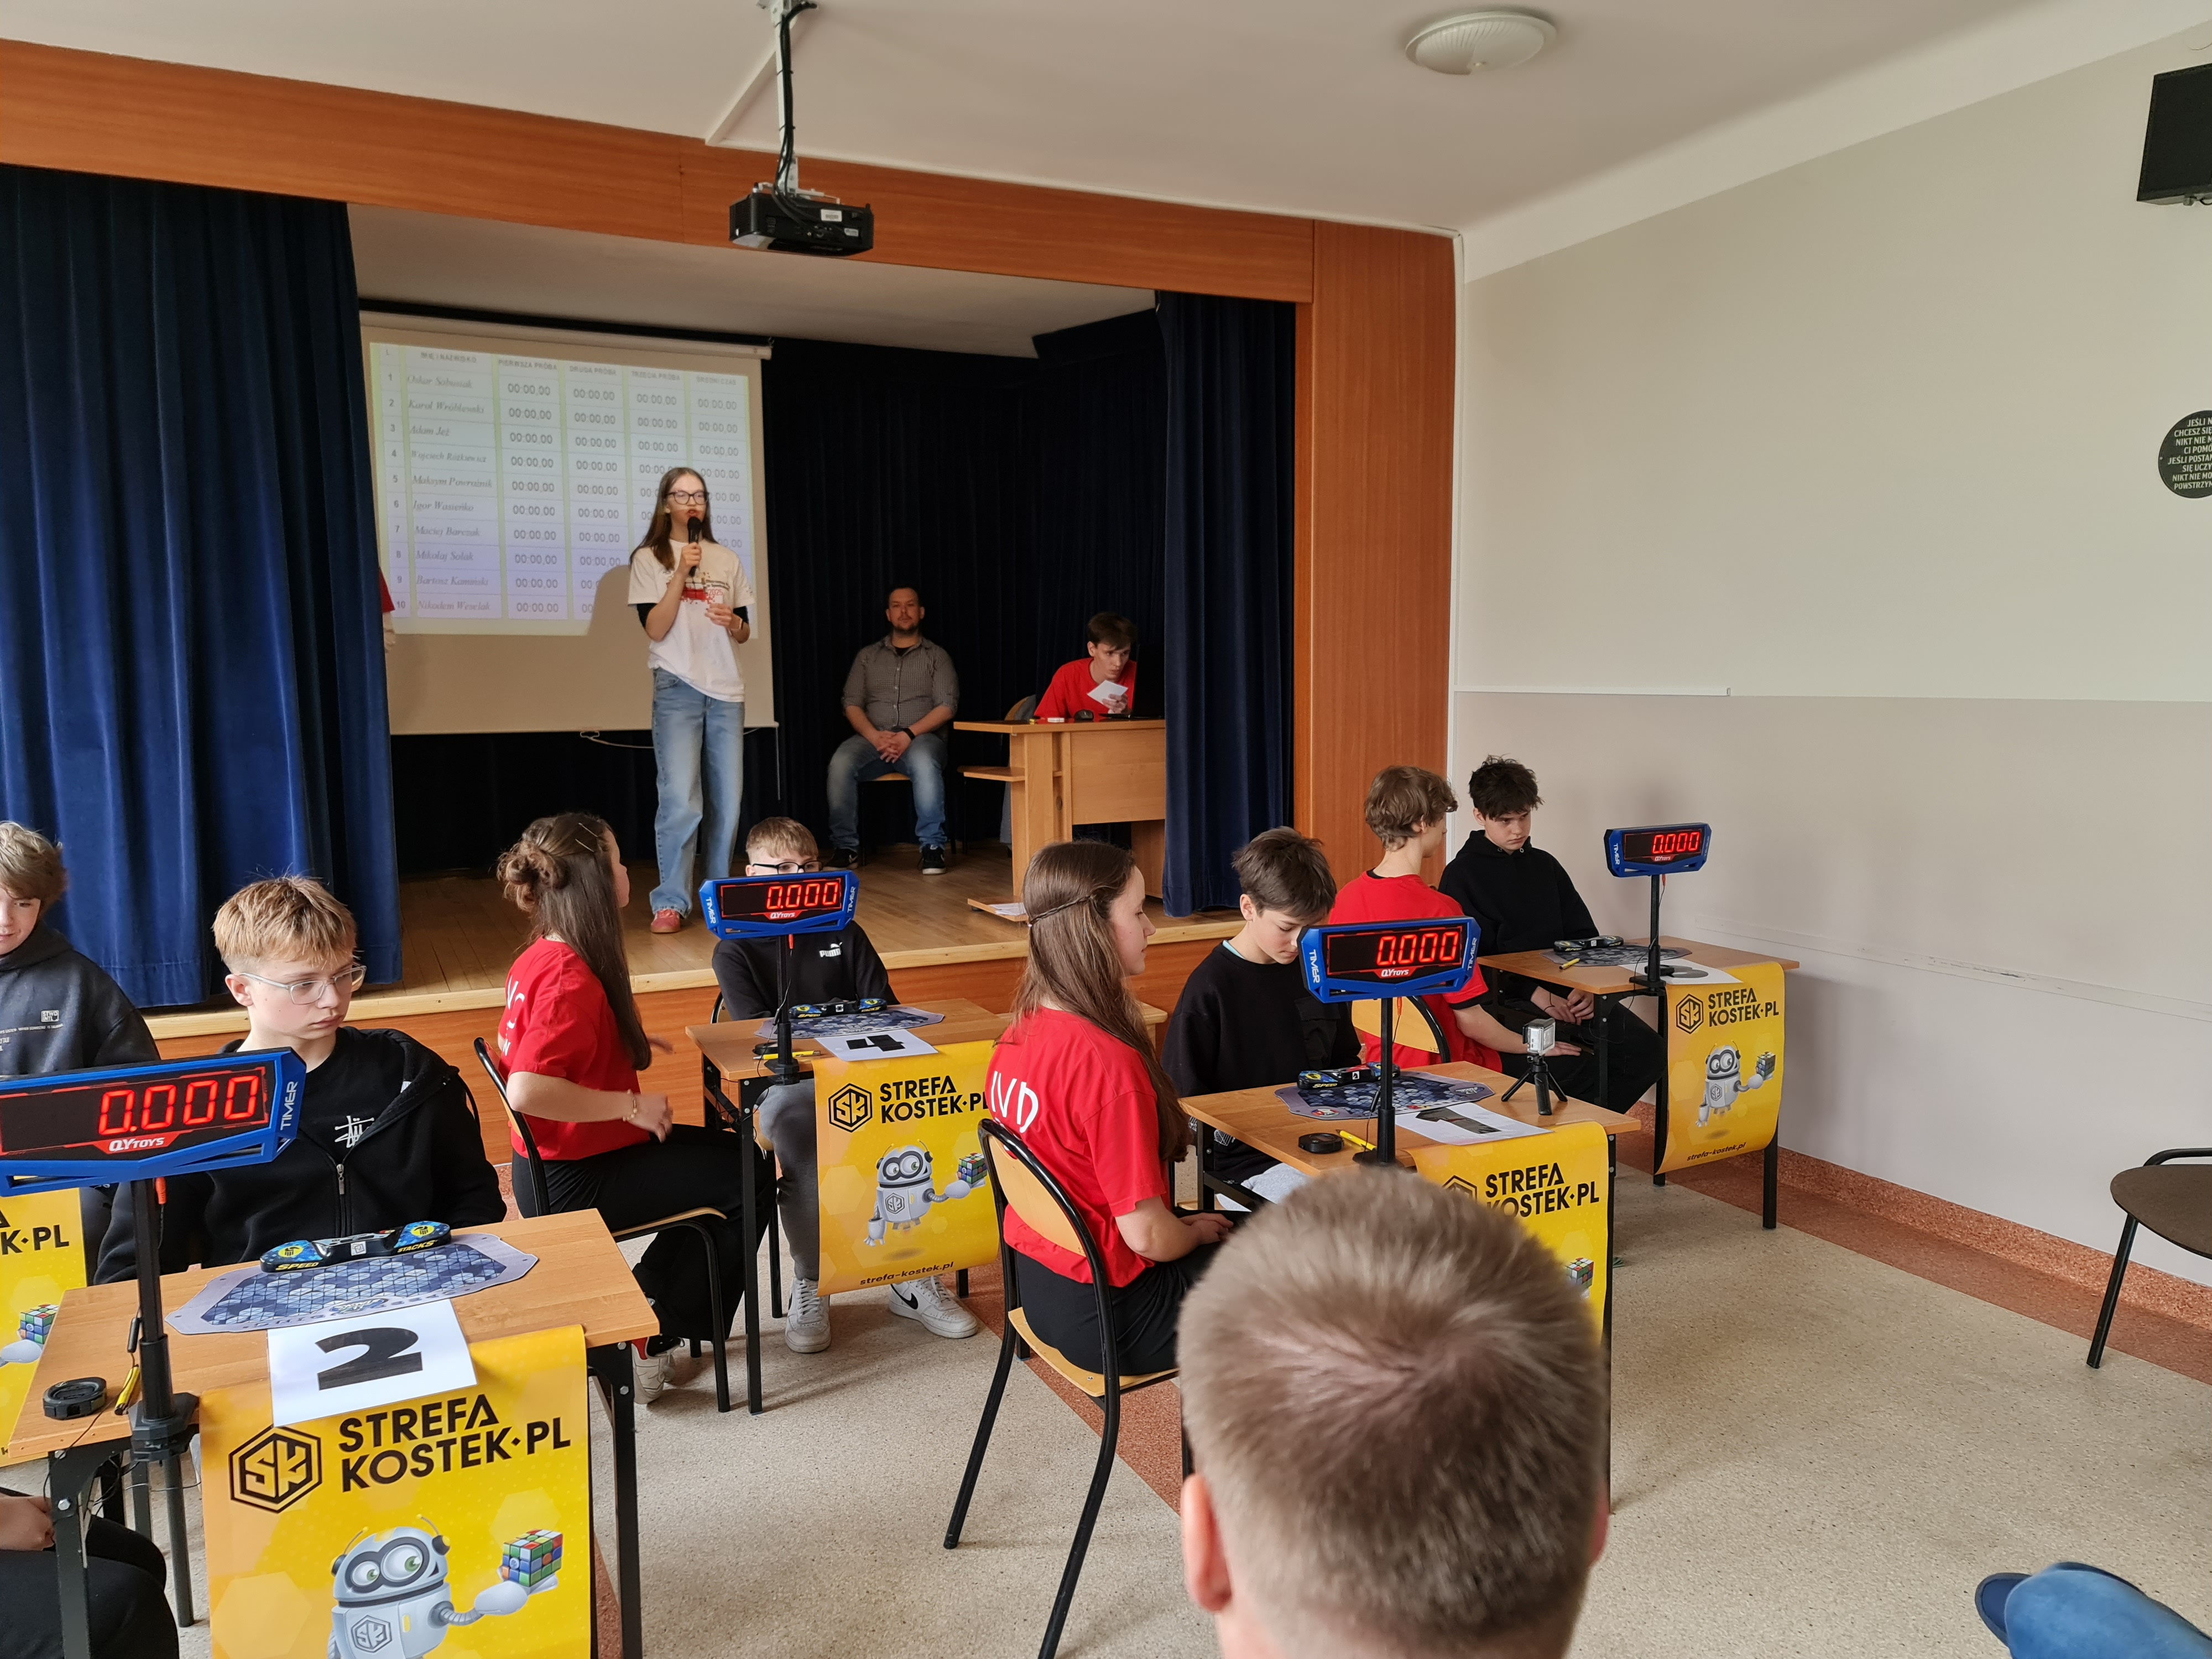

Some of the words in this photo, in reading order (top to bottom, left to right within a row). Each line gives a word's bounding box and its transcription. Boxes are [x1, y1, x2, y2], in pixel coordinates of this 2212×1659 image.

[499, 359, 532, 368] PIERWSZA
[569, 366, 592, 374] DRUGA
[389, 399, 394, 407] 2
[409, 399, 433, 410] Karol
[2187, 417, 2206, 427] JEŚLI
[410, 425, 434, 435] Adam
[2174, 427, 2201, 437] CHCESZ
[2176, 437, 2193, 446] NIKT
[2194, 436, 2206, 445] NIE
[411, 450, 445, 462] Wojciech
[2184, 446, 2191, 455] CI
[2168, 455, 2188, 465] JEŚLI
[2182, 465, 2193, 473] SIĘ
[393, 474, 398, 483] 5
[413, 475, 447, 487] Maksym
[2172, 473, 2189, 482] NIKT
[2189, 472, 2201, 481] NIE
[414, 500, 431, 512] Igor
[416, 526, 444, 538] Maciej
[446, 527, 480, 537] Barczak
[416, 575, 448, 585] Bartosz
[418, 601, 455, 610] Nikodem
[1652, 832, 1700, 854] 0.000
[766, 881, 839, 911] 0.000
[847, 886, 856, 914] TIMER
[705, 896, 717, 925] TIMER
[819, 948, 842, 957] PUMA
[1376, 931, 1458, 966] 0.000
[1467, 937, 1478, 971] TIMER
[1309, 948, 1321, 984] TIMER
[1708, 988, 1757, 1010] STREFA
[846, 1034, 906, 1052] 4
[880, 1075, 957, 1103] STREFA
[98, 1075, 260, 1136] 0.000
[280, 1080, 299, 1131] TIMER
[1416, 1107, 1501, 1134] 1
[1687, 1141, 1746, 1161] strefa-kostek.pl
[1485, 1162, 1564, 1198] STREFA
[275, 1261, 320, 1271] SPEED
[859, 1261, 954, 1286] strefa-kostek.pl
[315, 1327, 424, 1390] 2
[338, 1393, 499, 1452] STREFA
